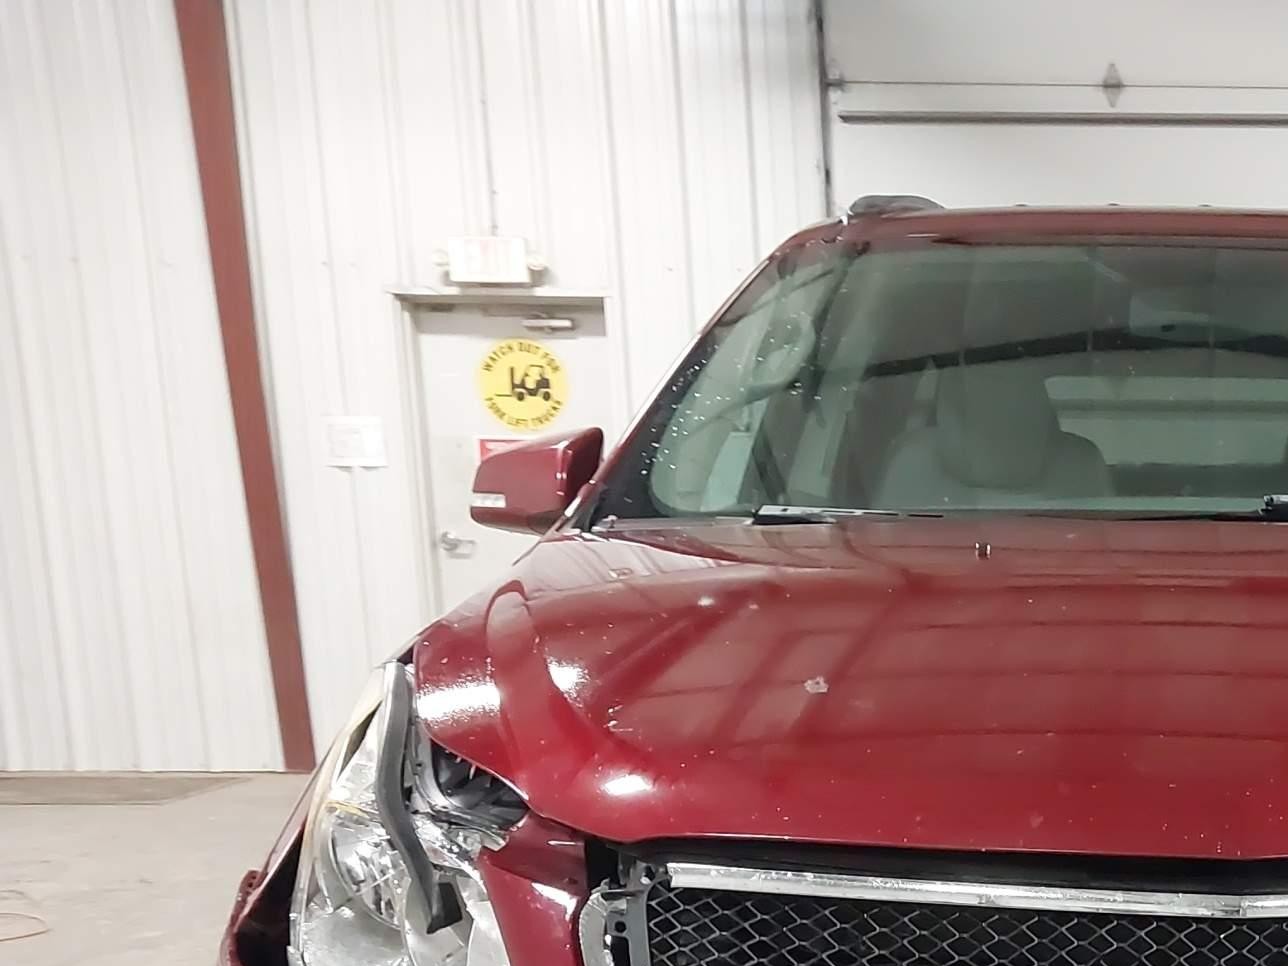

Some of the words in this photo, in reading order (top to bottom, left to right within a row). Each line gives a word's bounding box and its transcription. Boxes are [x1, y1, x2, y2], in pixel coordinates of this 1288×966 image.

[482, 343, 514, 372] WATCH
[518, 342, 541, 355] OUT
[541, 351, 561, 373] FOR
